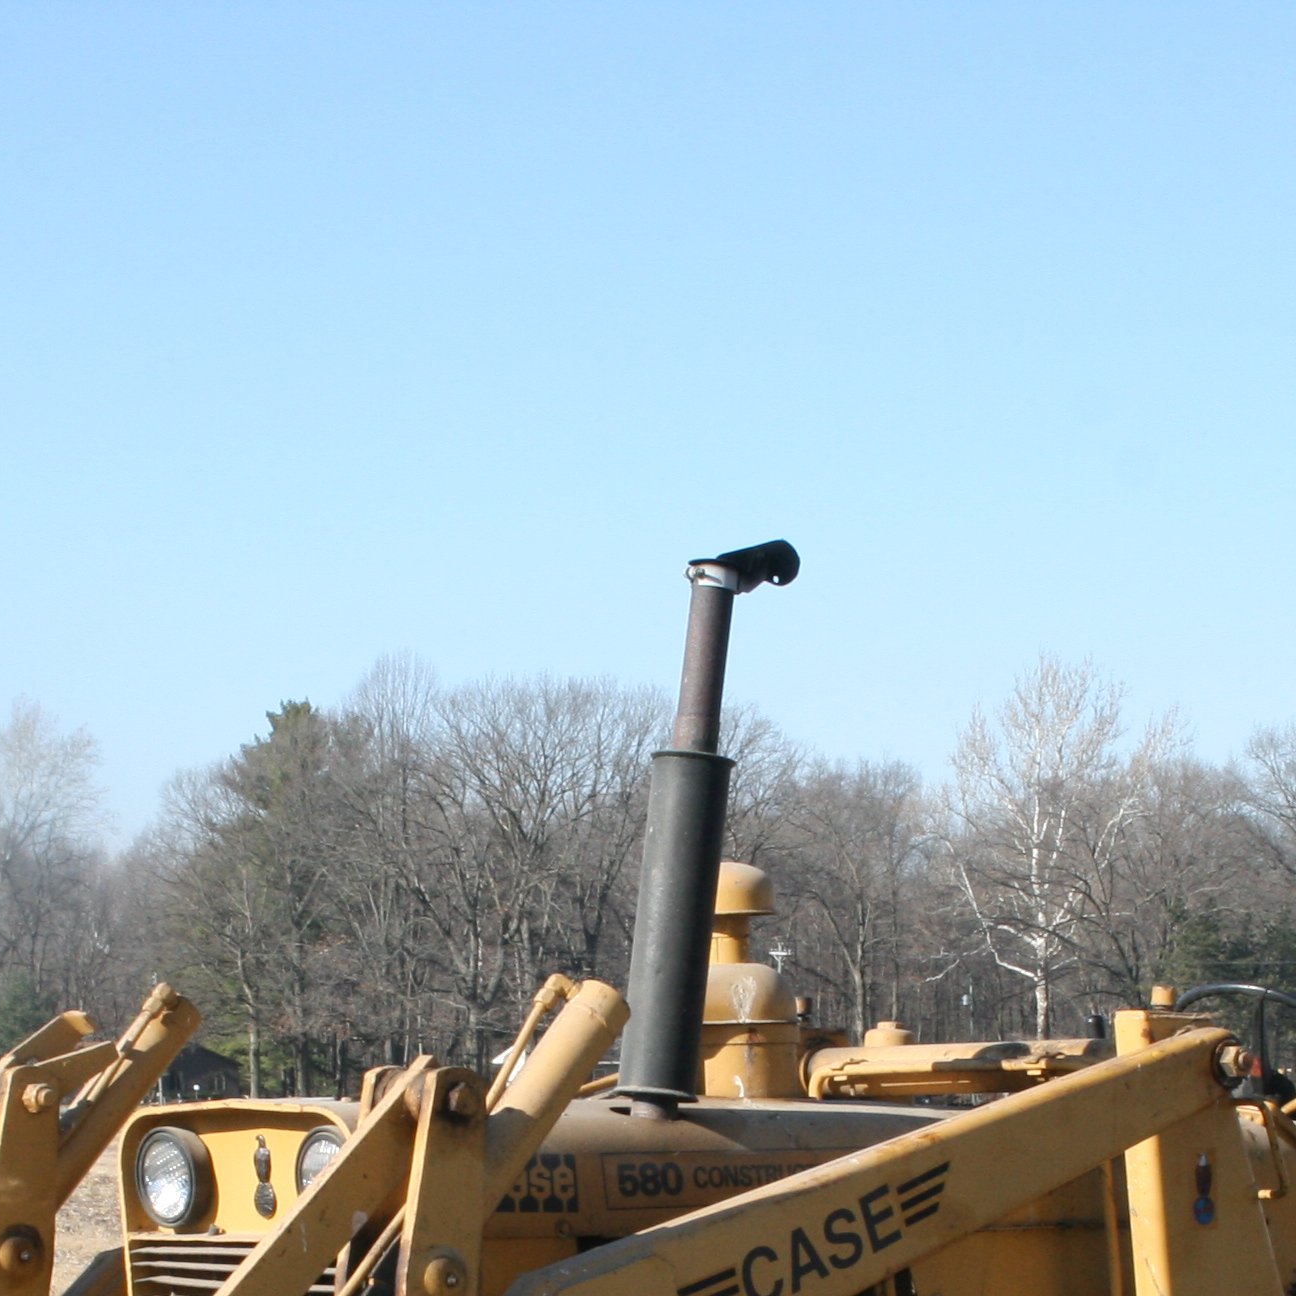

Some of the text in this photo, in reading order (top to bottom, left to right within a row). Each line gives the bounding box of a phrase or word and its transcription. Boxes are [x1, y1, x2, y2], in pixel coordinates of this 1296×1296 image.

[503, 1155, 579, 1211] ase
[617, 1162, 817, 1197] 580 CONSTRU
